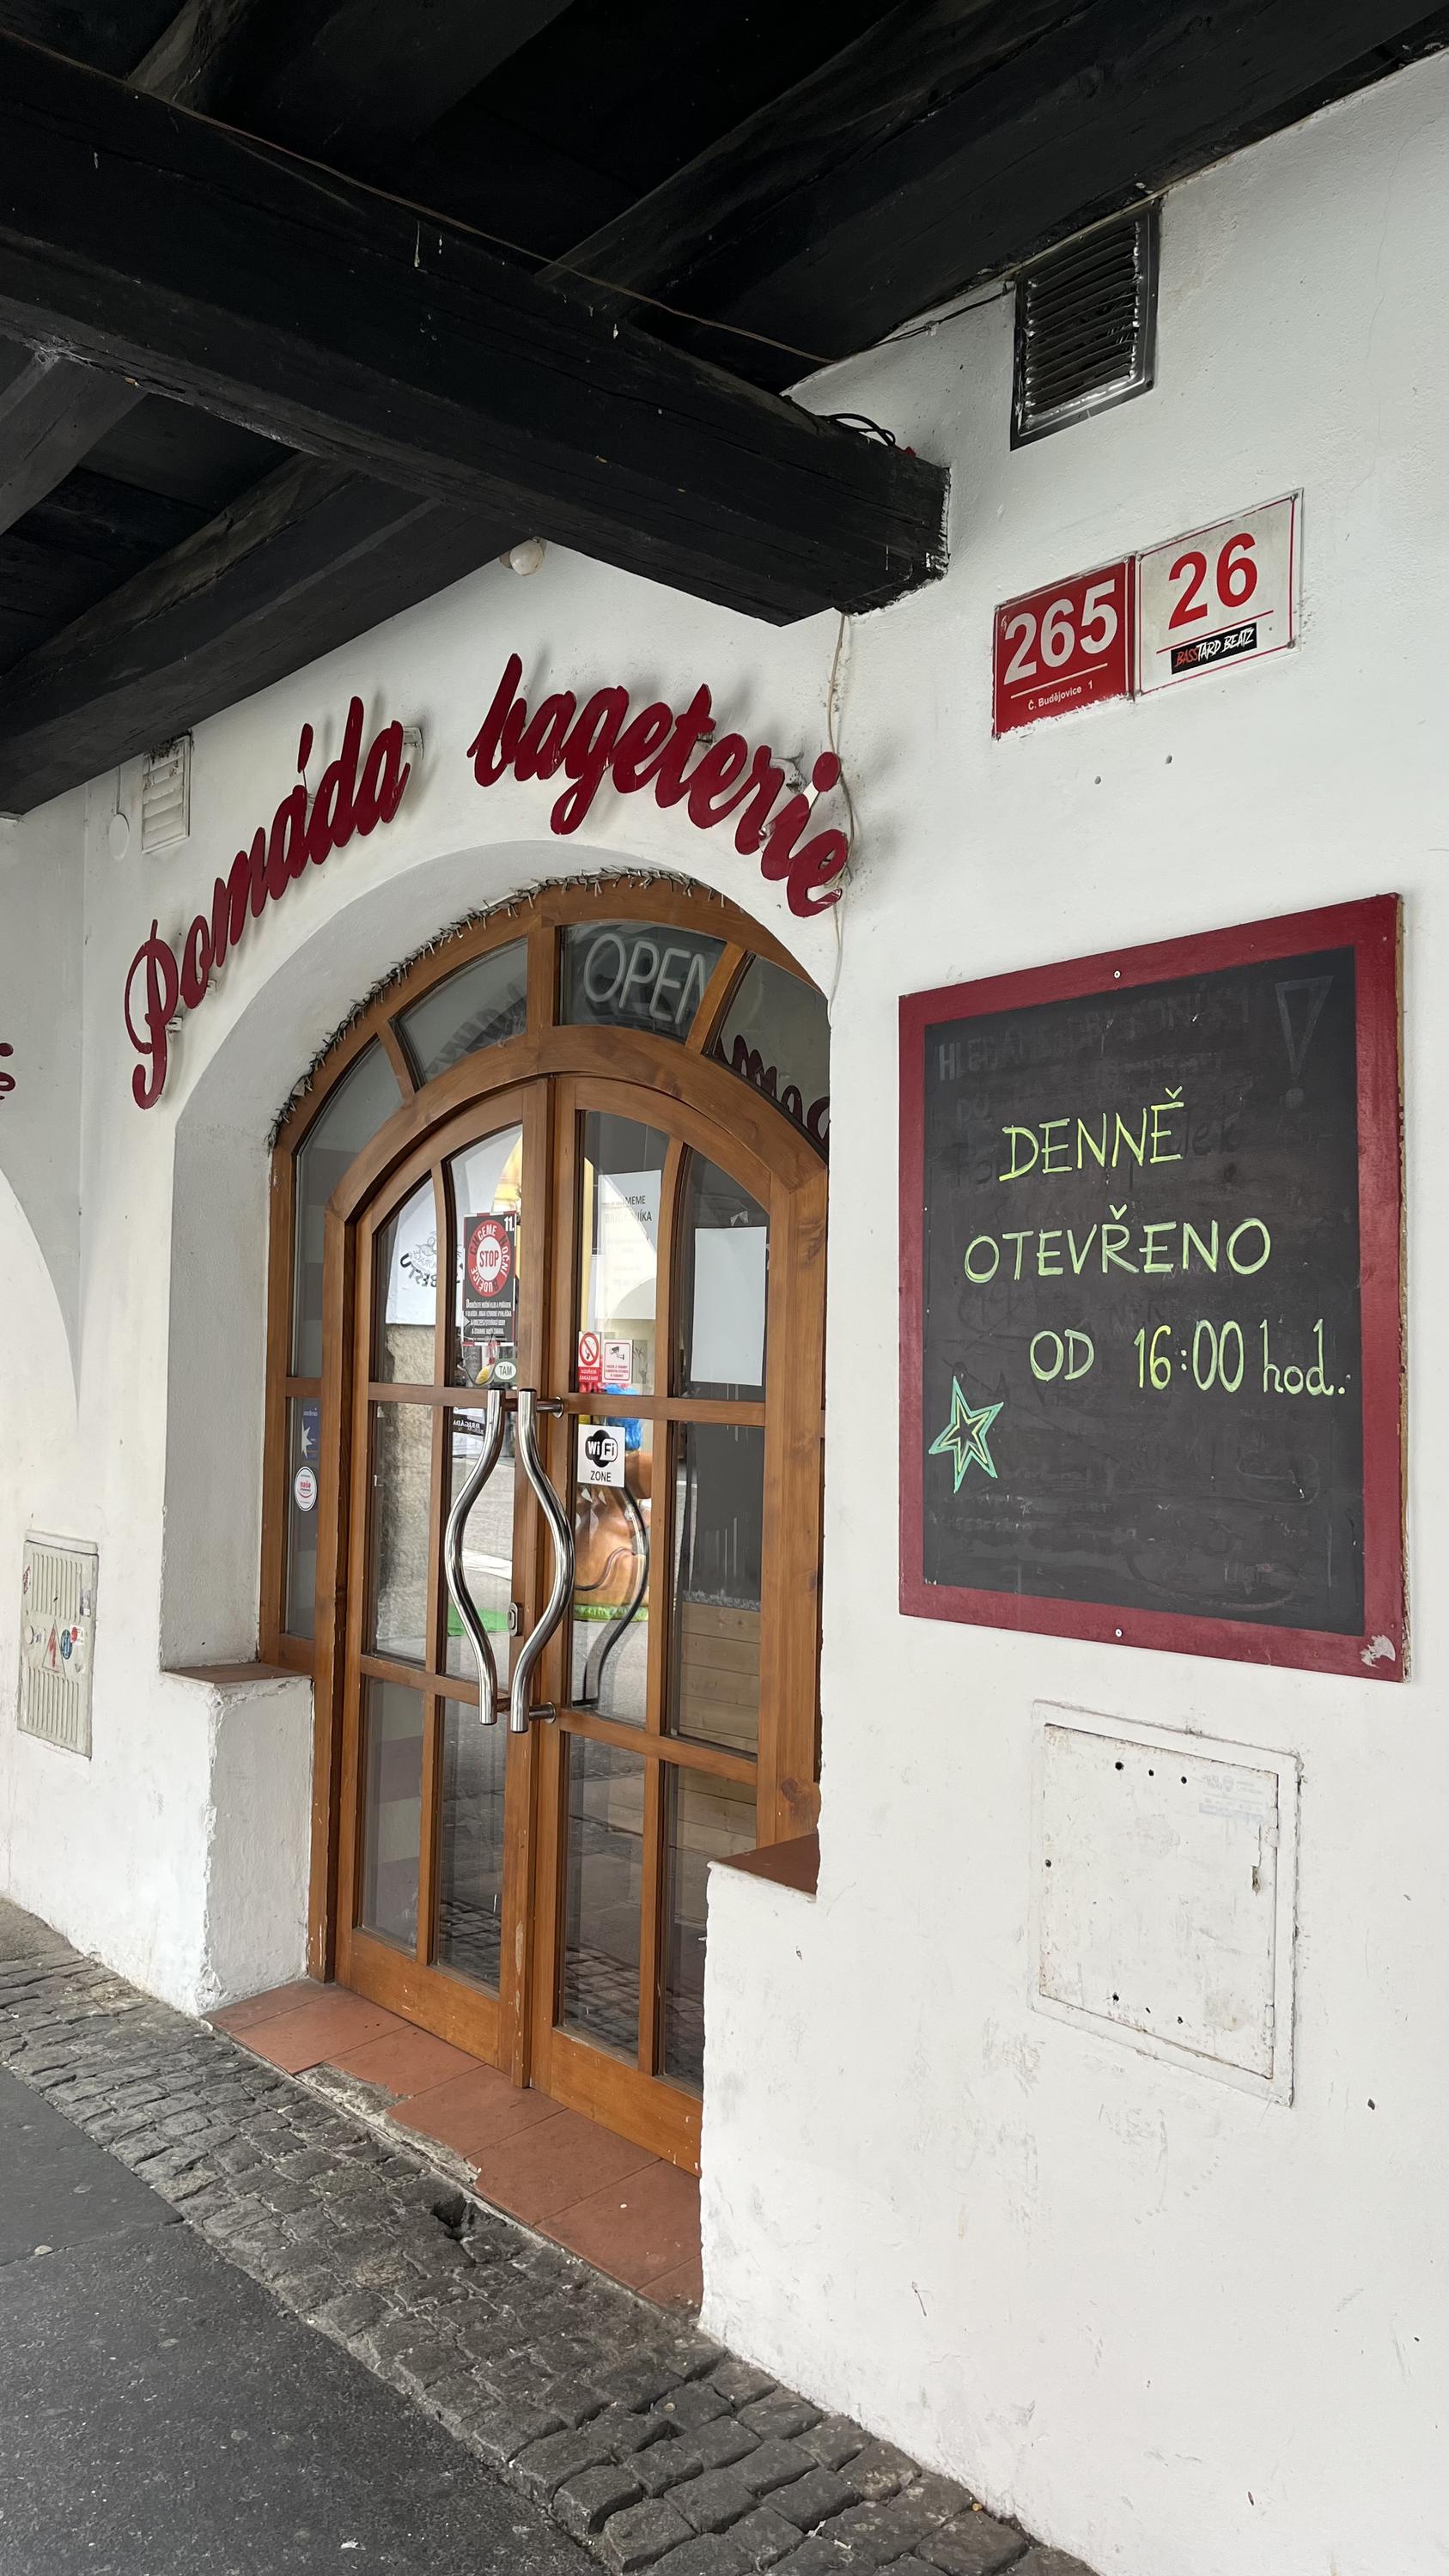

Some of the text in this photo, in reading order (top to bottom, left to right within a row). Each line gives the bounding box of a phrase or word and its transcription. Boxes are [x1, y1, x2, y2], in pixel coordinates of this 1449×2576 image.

[1168, 532, 1258, 631] 26
[1003, 579, 1118, 685] 265
[1174, 627, 1256, 668] BASSTARD BEATZ
[1027, 679, 1093, 711] Č. Budějovice 1
[125, 653, 850, 1110] Pomáda bageterie
[998, 1085, 1184, 1182] DENNĚ
[503, 1216, 514, 1232] 11.
[963, 1203, 1271, 1284] OTEVŘENO
[479, 1249, 499, 1267] STOP
[498, 1365, 513, 1376] TAM
[1030, 1317, 1347, 1396] OD 16:00 hod.
[588, 1440, 615, 1456] WiFi
[590, 1470, 612, 1483] ZONE
